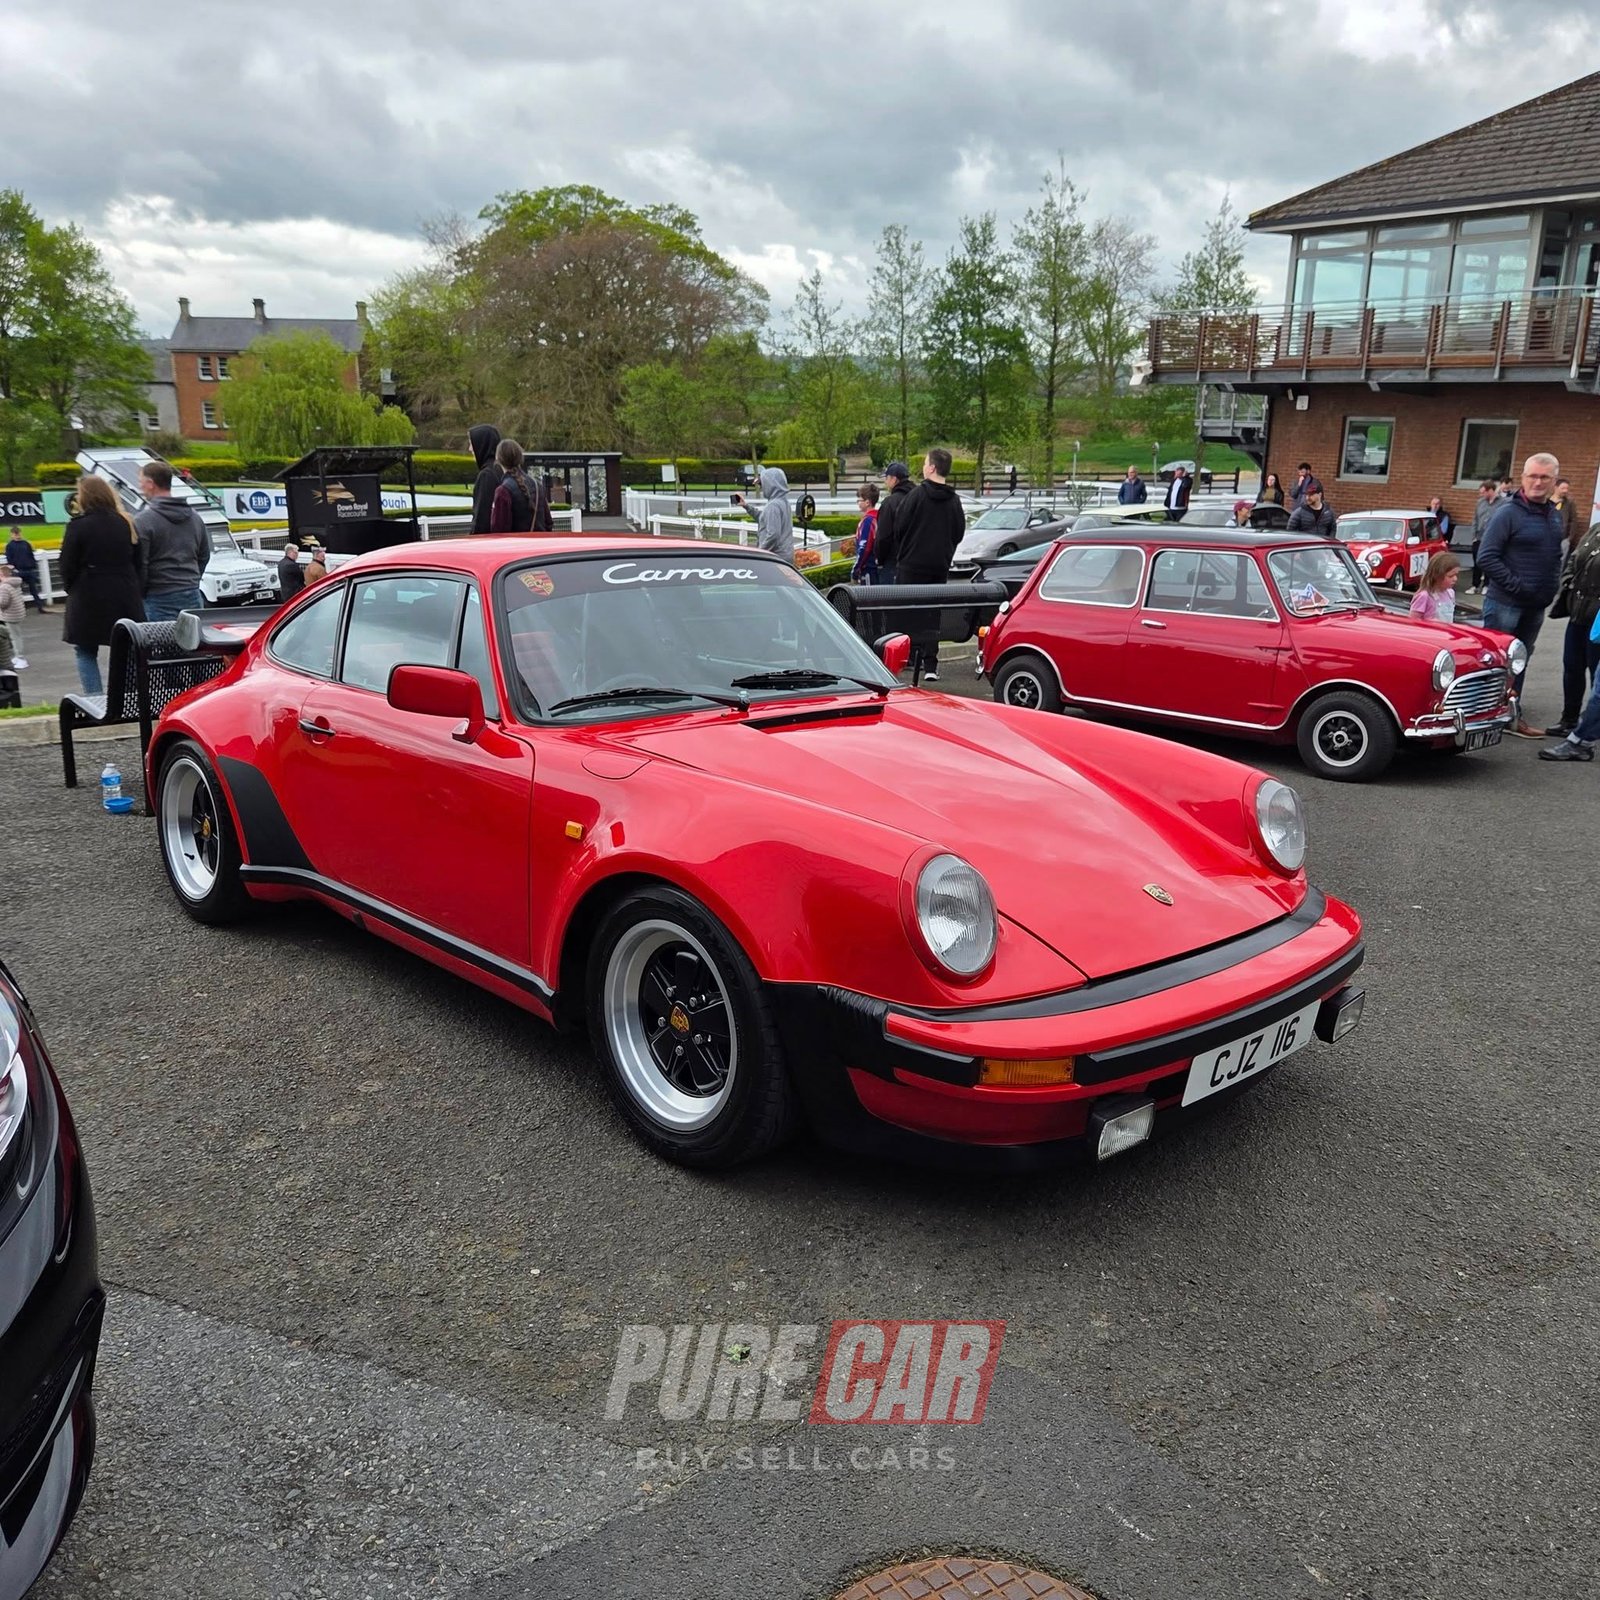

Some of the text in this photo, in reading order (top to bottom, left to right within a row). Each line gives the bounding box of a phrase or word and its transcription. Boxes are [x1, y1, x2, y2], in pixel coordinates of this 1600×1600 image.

[7, 501, 45, 517] GIN
[251, 495, 270, 507] EBF
[353, 502, 368, 512] Royal
[602, 563, 758, 584] Carrera
[1210, 1015, 1300, 1088] CJZ 116
